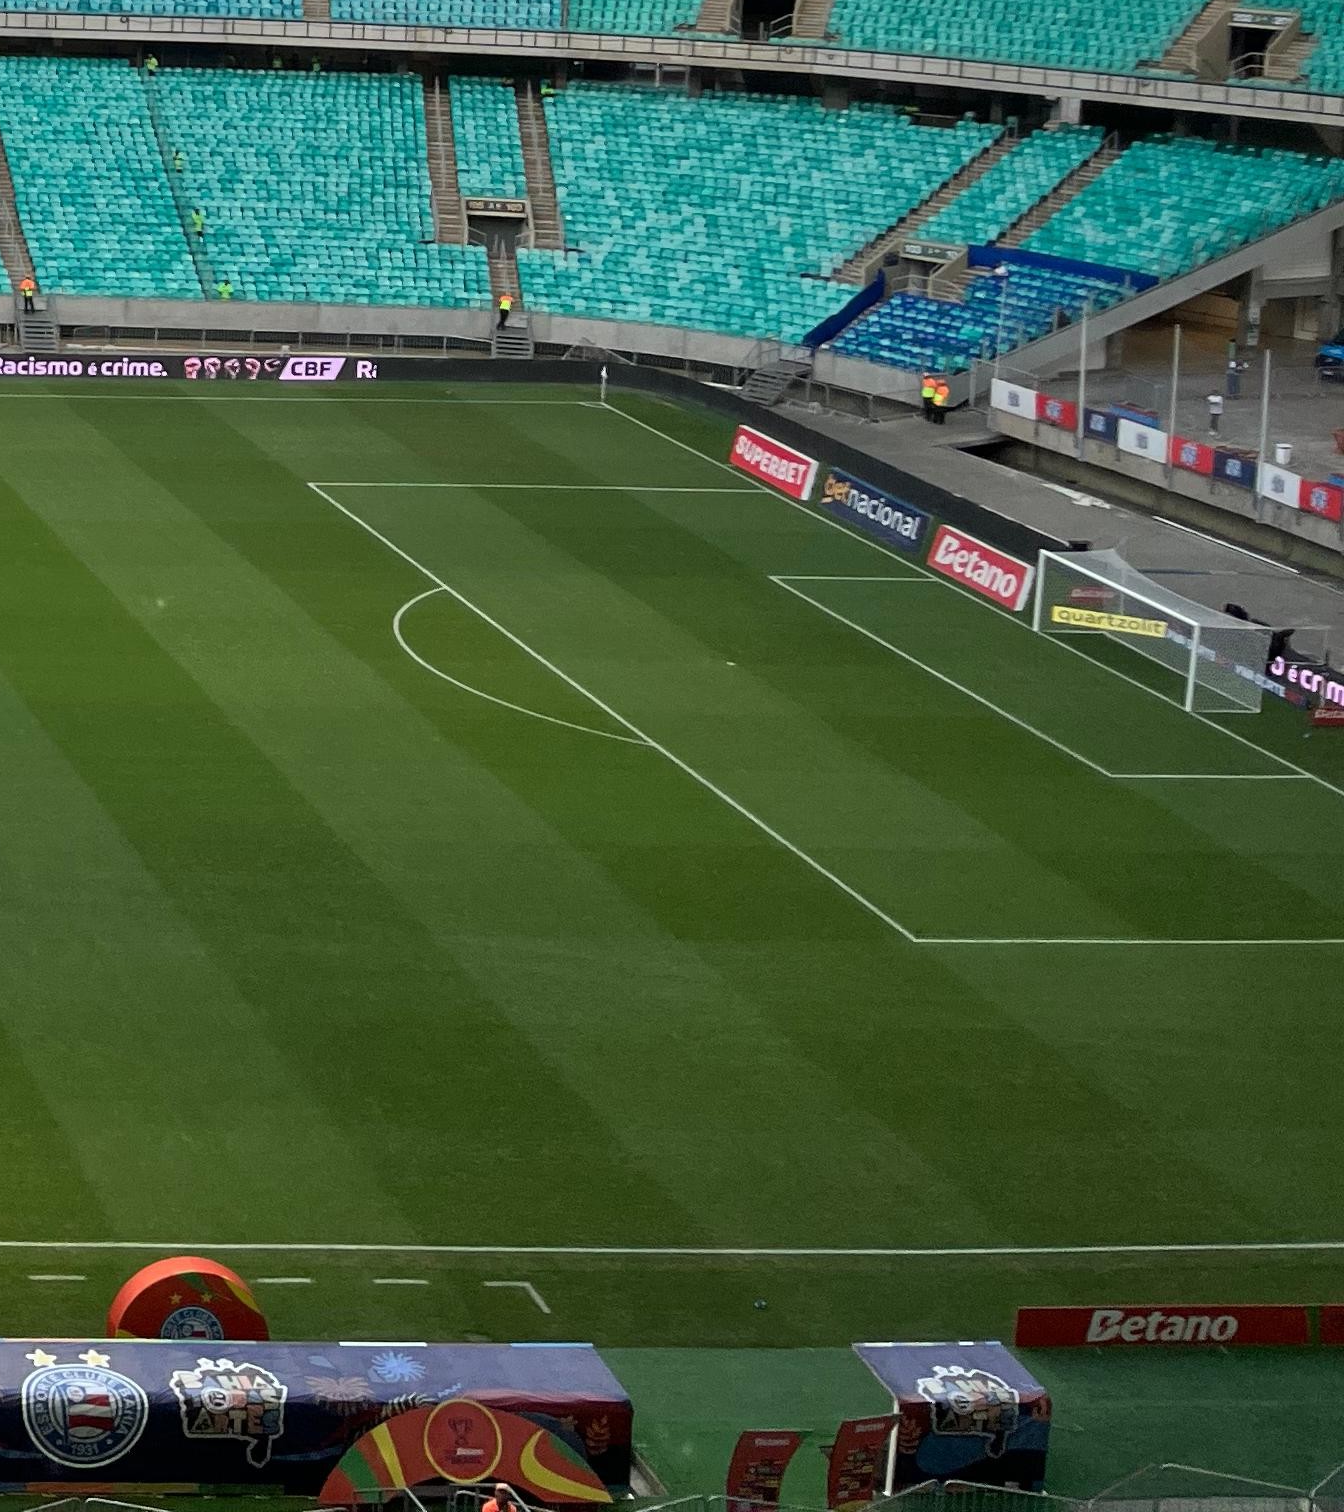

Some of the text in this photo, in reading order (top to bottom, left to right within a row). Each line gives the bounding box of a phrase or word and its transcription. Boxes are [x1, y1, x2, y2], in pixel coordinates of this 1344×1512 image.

[101, 357, 167, 377] crime.
[290, 361, 332, 377] CBF
[735, 435, 806, 486] SUPERBET
[932, 534, 1017, 598] Betano
[1058, 609, 1162, 635] quartzolit
[1086, 1309, 1239, 1342] Betano
